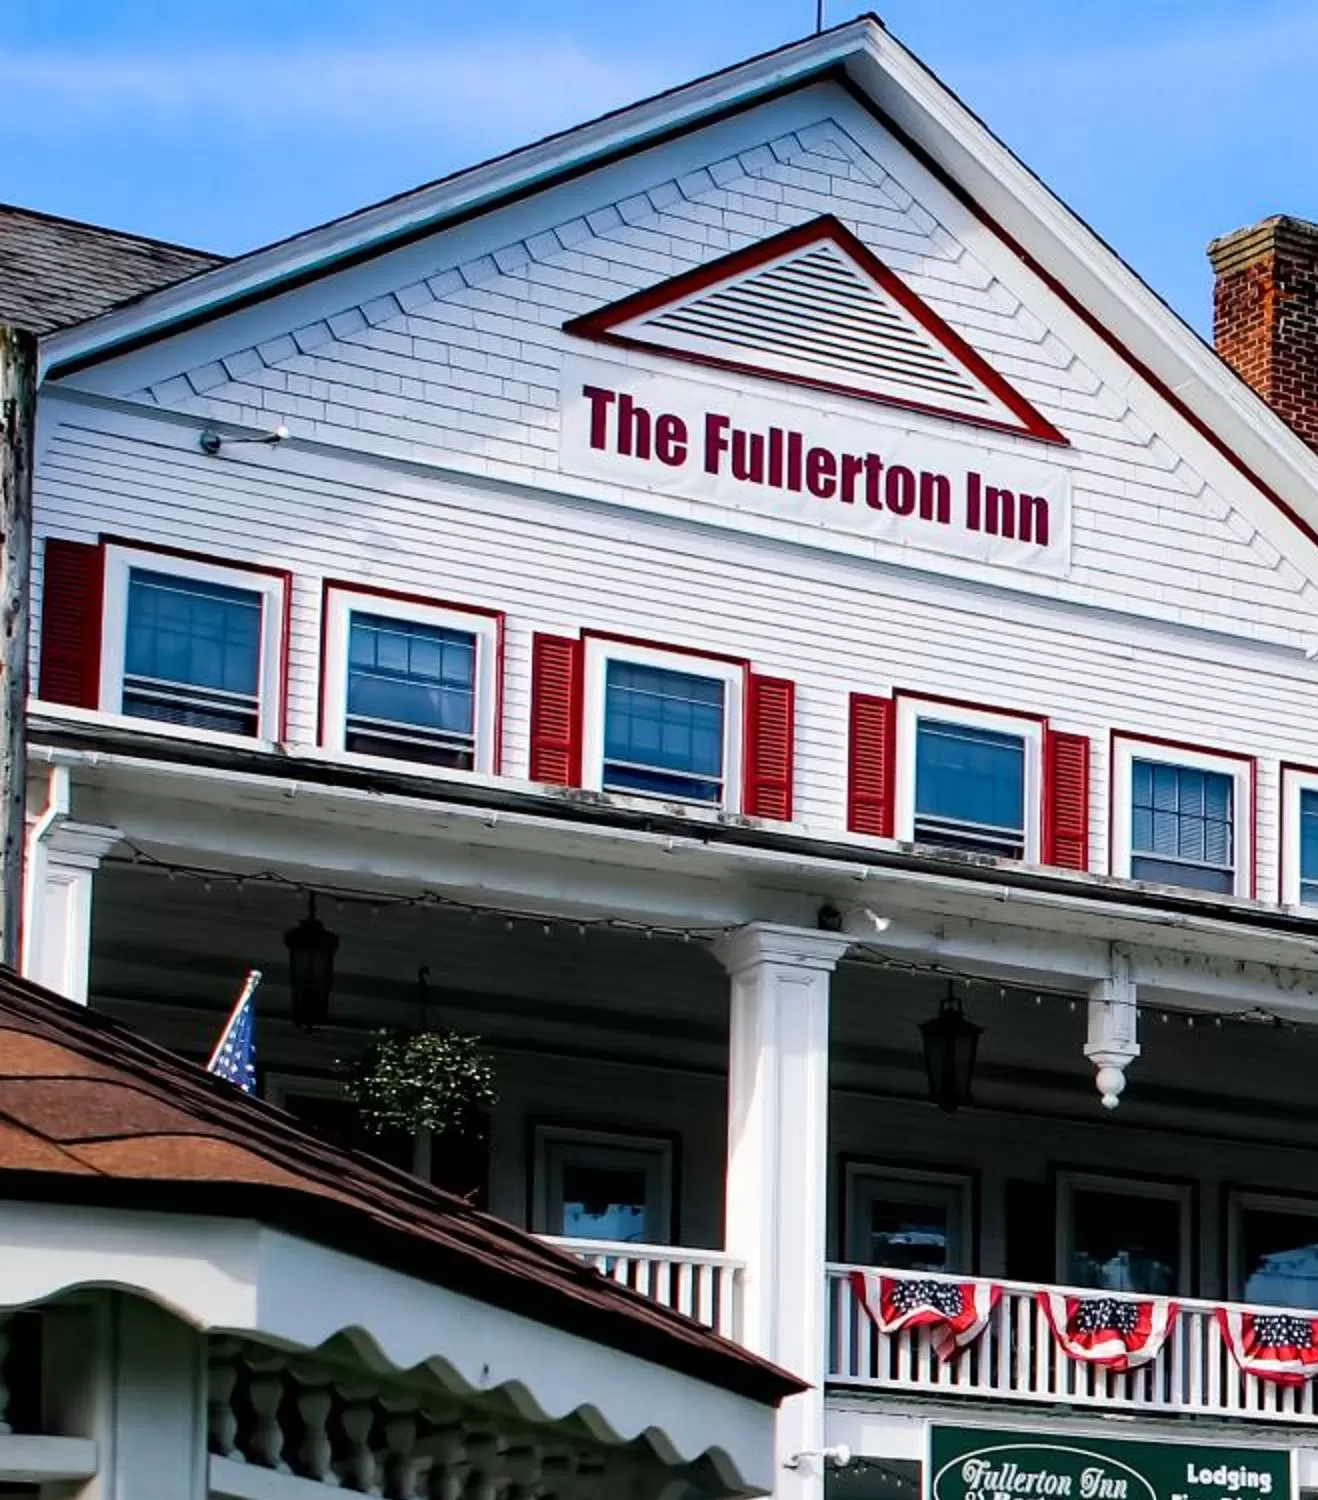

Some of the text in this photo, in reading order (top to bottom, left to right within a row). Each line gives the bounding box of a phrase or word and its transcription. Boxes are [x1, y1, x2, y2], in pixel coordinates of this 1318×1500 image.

[583, 384, 1050, 547] The Fullerton Inn
[961, 1458, 1128, 1499] Fullerton Inn
[1186, 1462, 1273, 1493] Lodging
